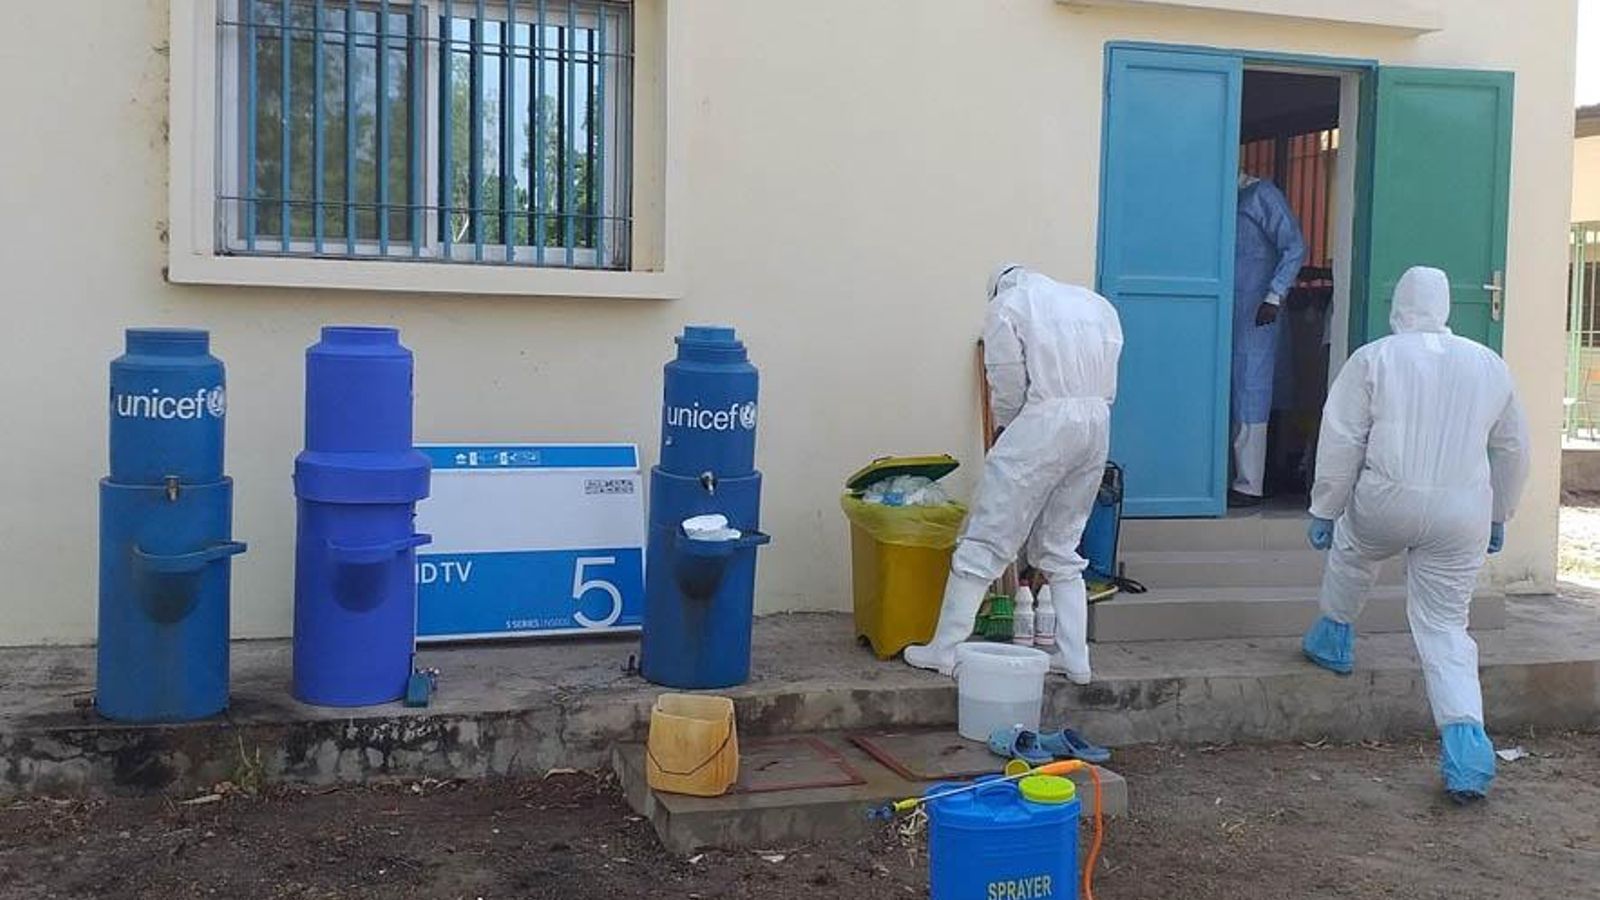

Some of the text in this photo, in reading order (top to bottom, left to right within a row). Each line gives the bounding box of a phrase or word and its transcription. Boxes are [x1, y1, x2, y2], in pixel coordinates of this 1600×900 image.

[118, 388, 206, 419] unicef
[667, 401, 739, 430] unicef
[572, 556, 622, 628] 5
[988, 875, 1052, 900] SPRAYER
